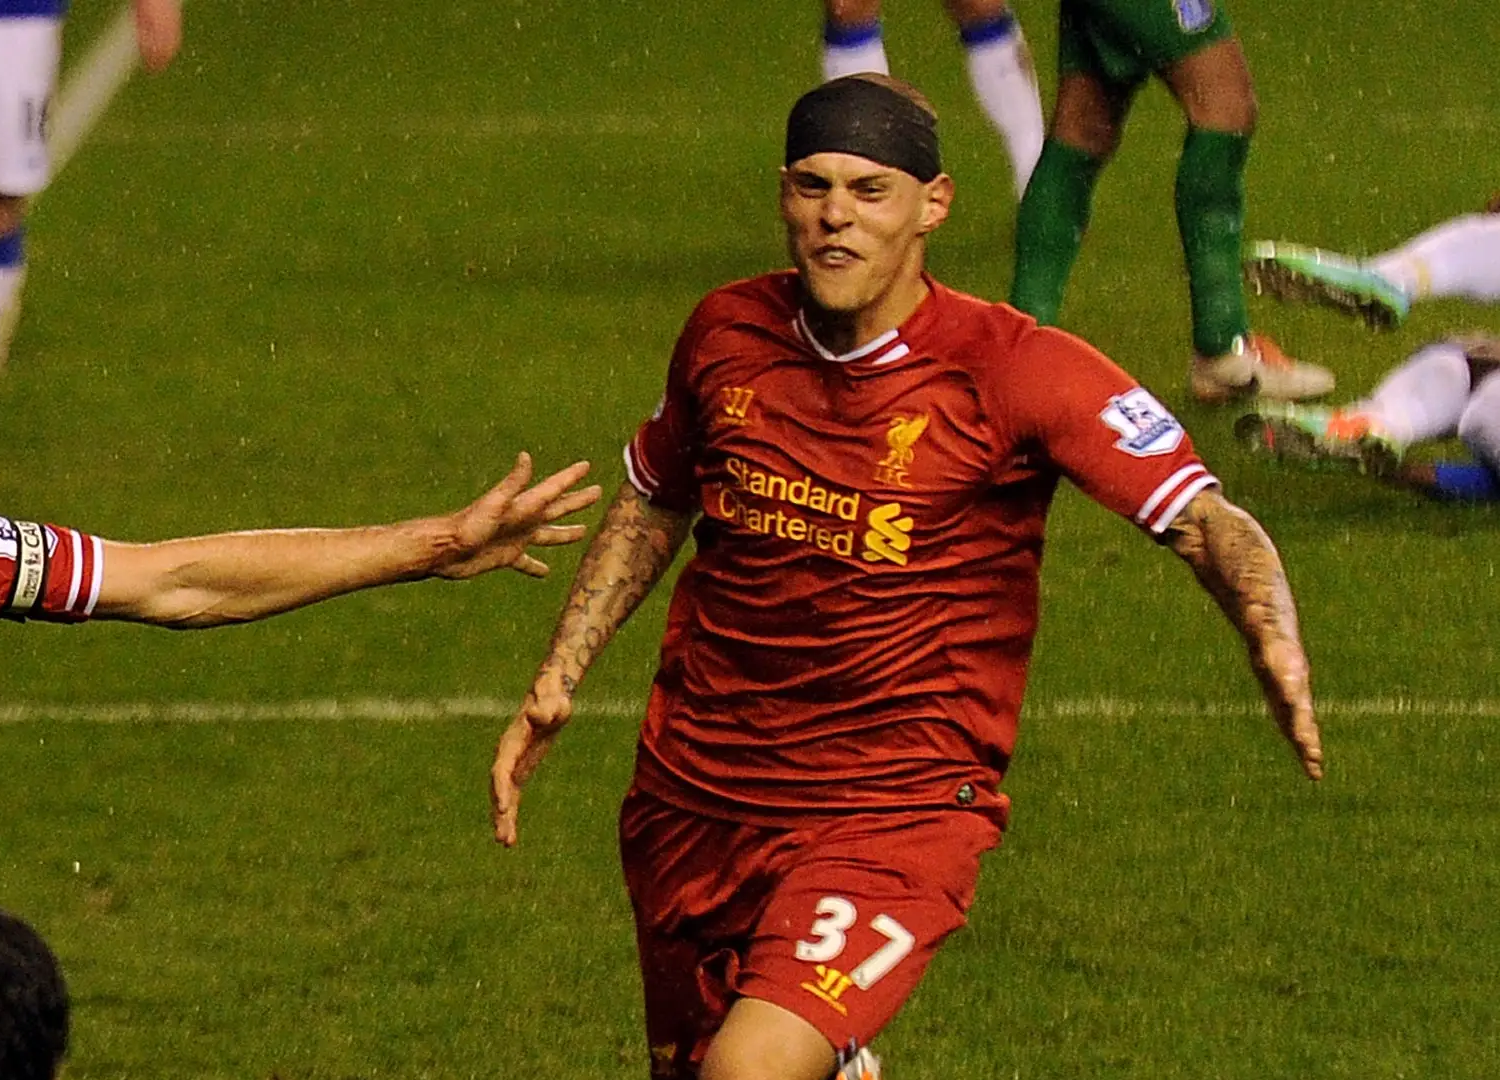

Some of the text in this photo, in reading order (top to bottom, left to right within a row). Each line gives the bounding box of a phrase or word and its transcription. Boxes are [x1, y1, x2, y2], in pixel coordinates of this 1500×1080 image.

[718, 488, 854, 556] Chartered
[726, 457, 861, 521] Standard
[794, 896, 916, 991] 37
